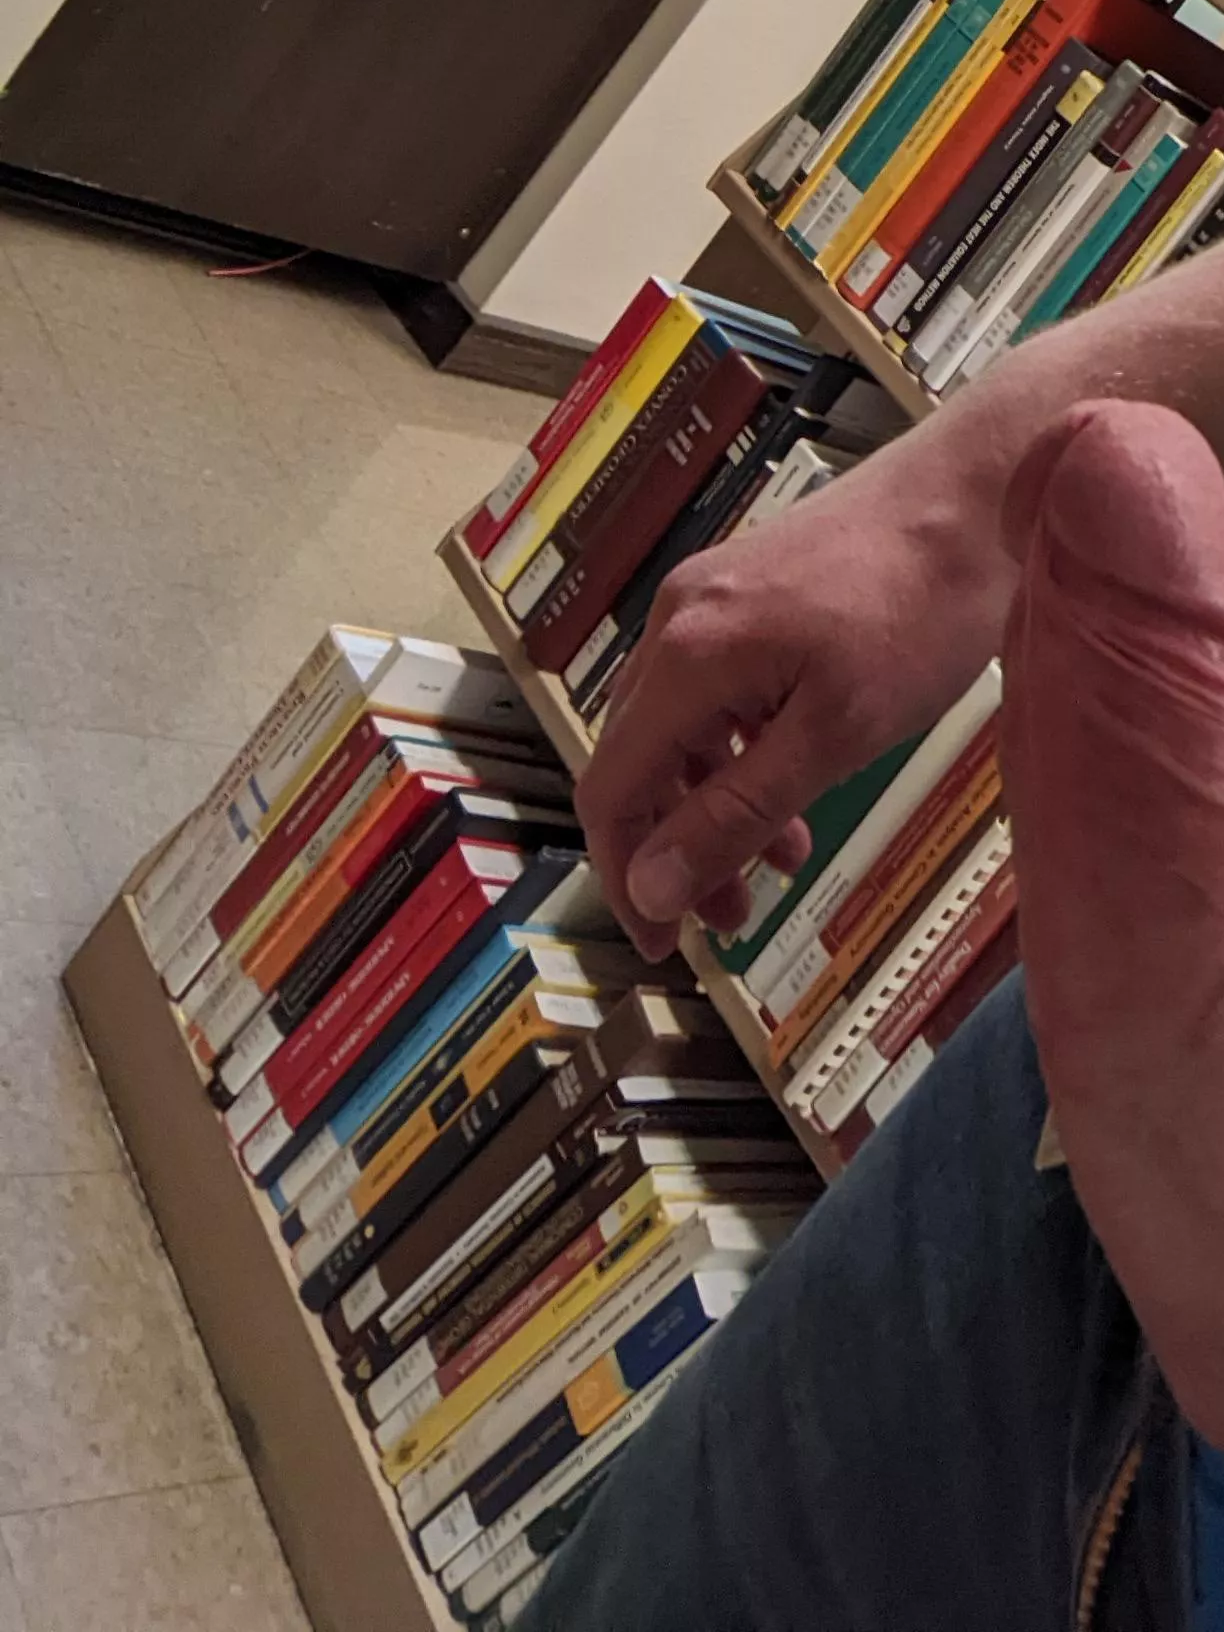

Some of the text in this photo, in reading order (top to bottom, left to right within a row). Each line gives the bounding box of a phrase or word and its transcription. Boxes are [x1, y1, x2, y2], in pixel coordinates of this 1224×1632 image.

[910, 118, 1061, 314] THE INDEX THEOREM AND THE HEAT EQUATION METHOD
[633, 362, 690, 433] CONVEX
[564, 431, 639, 526] GEOMETRY
[934, 802, 972, 843] Analysis
